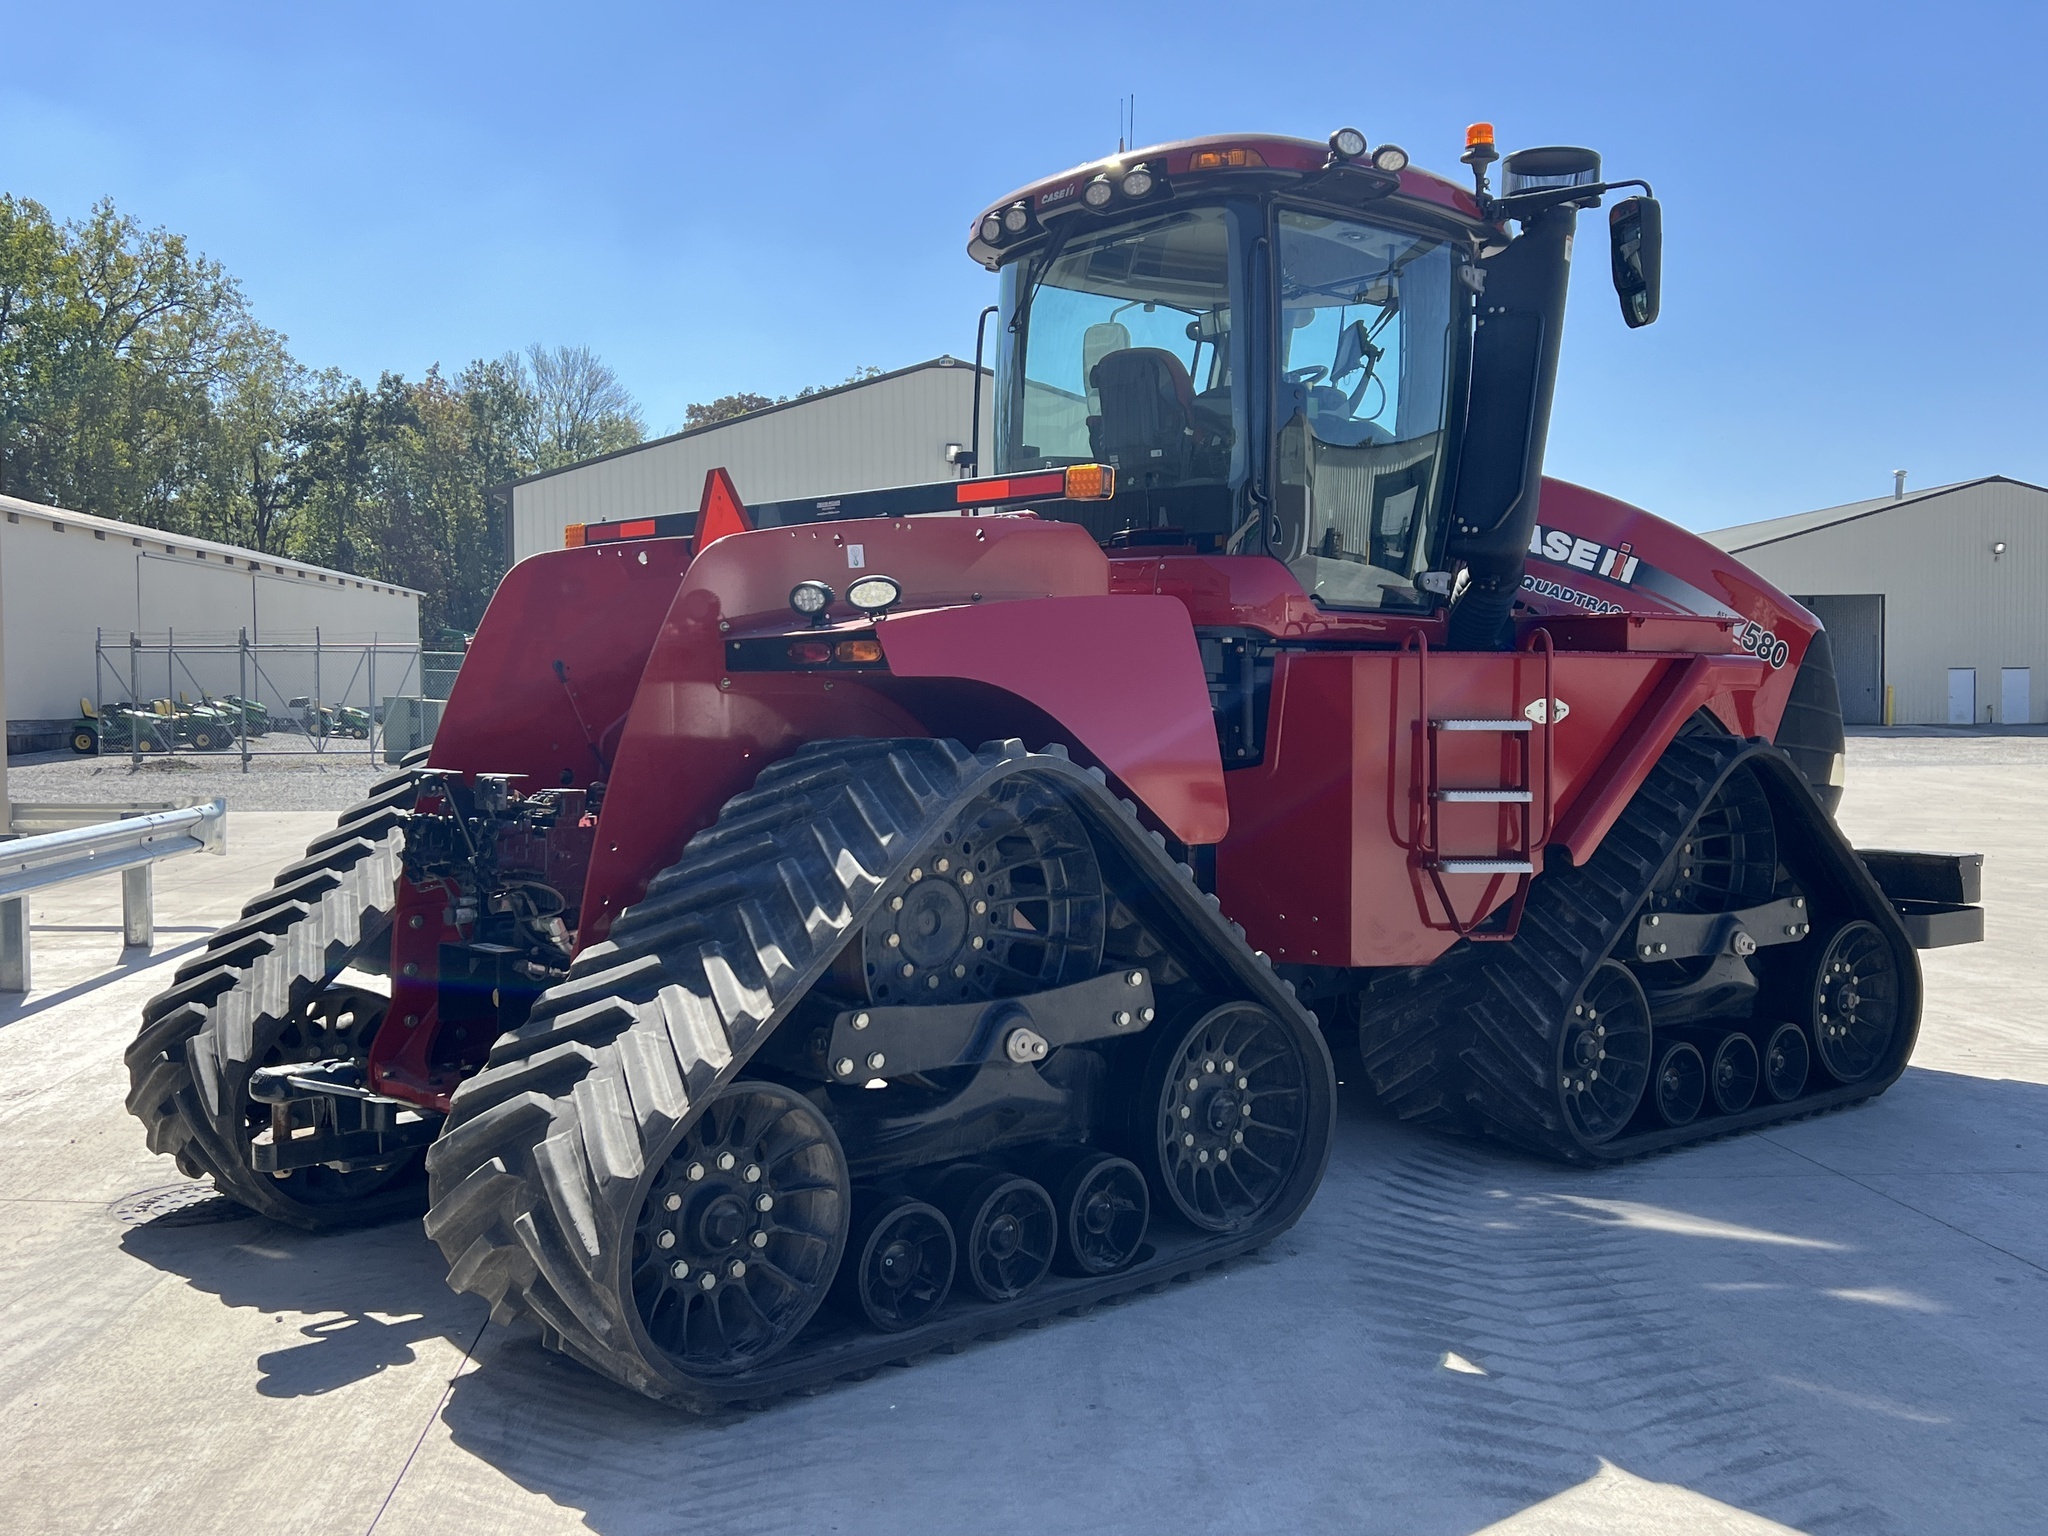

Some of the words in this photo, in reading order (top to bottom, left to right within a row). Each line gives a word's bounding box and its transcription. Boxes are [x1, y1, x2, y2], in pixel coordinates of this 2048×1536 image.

[1041, 189, 1066, 205] CASE
[1528, 524, 1601, 571] ASE
[1741, 620, 1789, 669] 580
